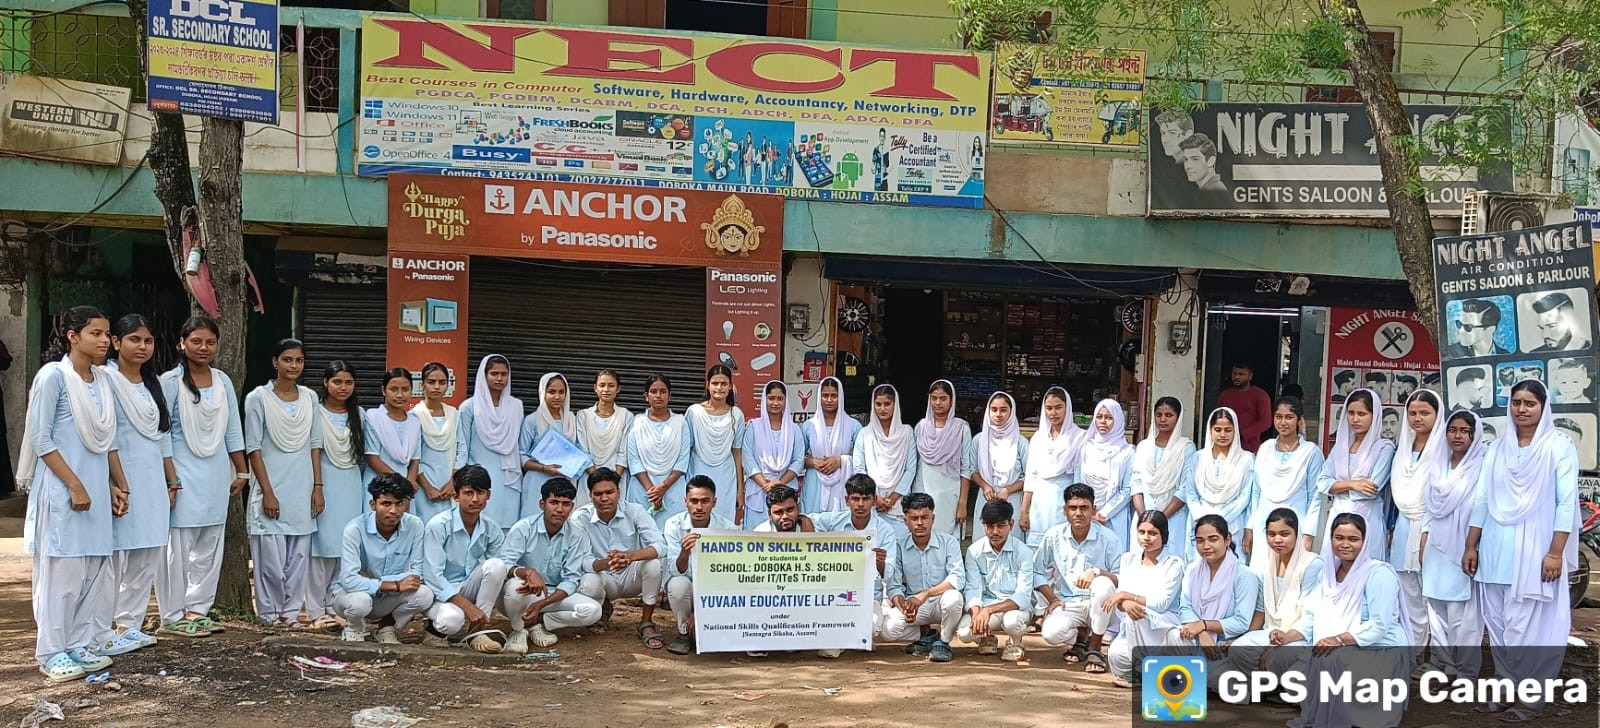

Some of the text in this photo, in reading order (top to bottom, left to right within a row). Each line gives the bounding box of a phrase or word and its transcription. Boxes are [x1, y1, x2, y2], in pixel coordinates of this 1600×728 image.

[152, 16, 273, 49] SR. SECONDARY SCHOOL
[371, 18, 980, 101] NECT
[366, 74, 977, 116] Best Courses in Computer Software, Hardware, Accountancy, Networking, DTP
[16, 102, 74, 116] WESTERN
[388, 102, 445, 111] Windows
[415, 89, 933, 126] PGDCA, PGDBM, DCABM, DCA, DCH, ADCH, DFA, ADCA, DFA
[501, 103, 552, 112] Learning
[32, 112, 73, 124] UNION
[387, 111, 444, 120] Windows
[23, 123, 47, 132] moving
[401, 121, 446, 129] Office
[922, 132, 932, 143] Be
[1217, 111, 1350, 159] NIGHT
[890, 134, 909, 151] Tally
[382, 149, 451, 160] OpenOffice 4
[462, 148, 519, 161] Busy
[908, 144, 937, 155] Certified
[899, 155, 937, 168] Accountant
[420, 194, 465, 207] Happy
[775, 187, 820, 200] DOBOKA
[831, 189, 862, 201] HOJAI
[872, 192, 909, 203] ASSAM
[1233, 186, 1294, 203] GENTS
[1298, 186, 1373, 203] SALOON
[522, 188, 687, 224] ANCHOR
[403, 202, 470, 225] Durga
[425, 219, 465, 241] Puja
[521, 226, 658, 250] by Panasonic
[1437, 225, 1590, 266] NIGHT ANGEL
[406, 259, 466, 271] ANCHOR
[1461, 256, 1565, 275] AIR CONDITION
[412, 272, 455, 281] Panasonic
[711, 270, 777, 283] Panasonic
[1442, 266, 1590, 294] GENTS SALOON & PARLOUR
[719, 285, 768, 294] LED Lighting
[1334, 313, 1371, 339] NIGHT
[1372, 309, 1408, 320] ANGEL
[404, 336, 452, 344] Wiring Devices
[1336, 359, 1353, 367] Main
[1403, 361, 1421, 369] Hojai
[701, 542, 864, 553] HANDS ON SKILL TRAINING
[710, 562, 854, 573] SCHOOL: DOBOKA H.S. SCHOOL
[738, 574, 826, 583] Under IT/ITeS Trade
[776, 584, 786, 592] by
[700, 594, 835, 609] YUVAAN EDUCATIVE LLP
[703, 621, 856, 631] National Skills Qualification Framework
